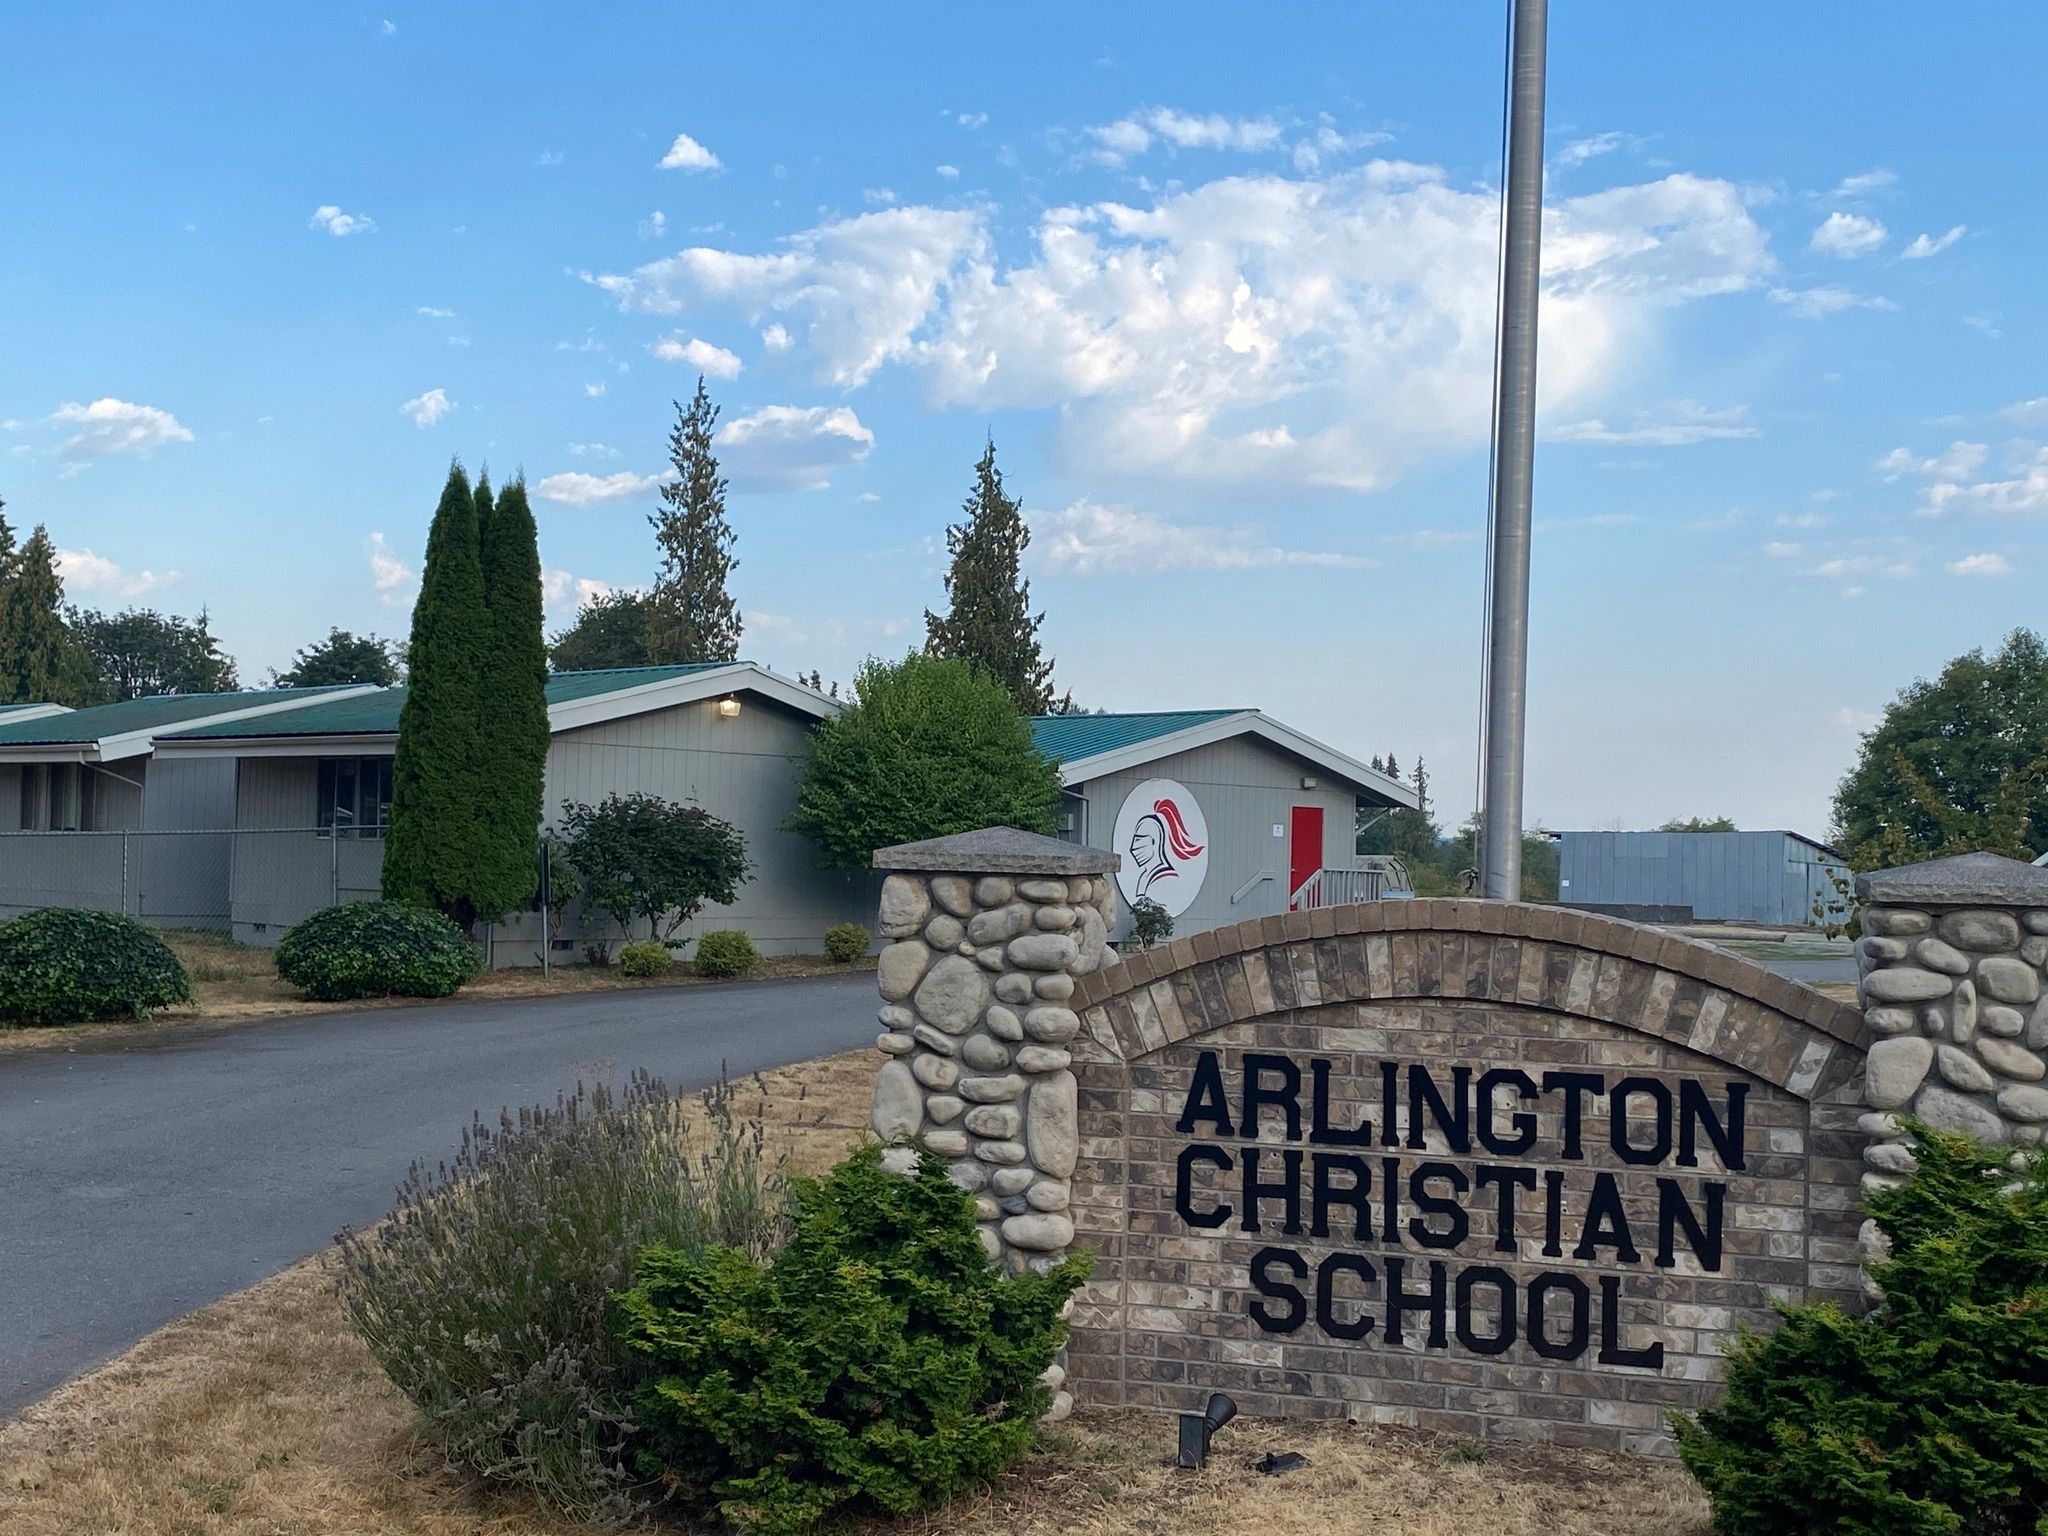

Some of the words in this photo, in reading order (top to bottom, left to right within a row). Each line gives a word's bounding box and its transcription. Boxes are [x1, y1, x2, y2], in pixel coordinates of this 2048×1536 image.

[1176, 1051, 1750, 1171] ARLINGTON
[1176, 1145, 1726, 1271] CHRISTIAN
[1249, 1247, 1664, 1368] SCHOOL
